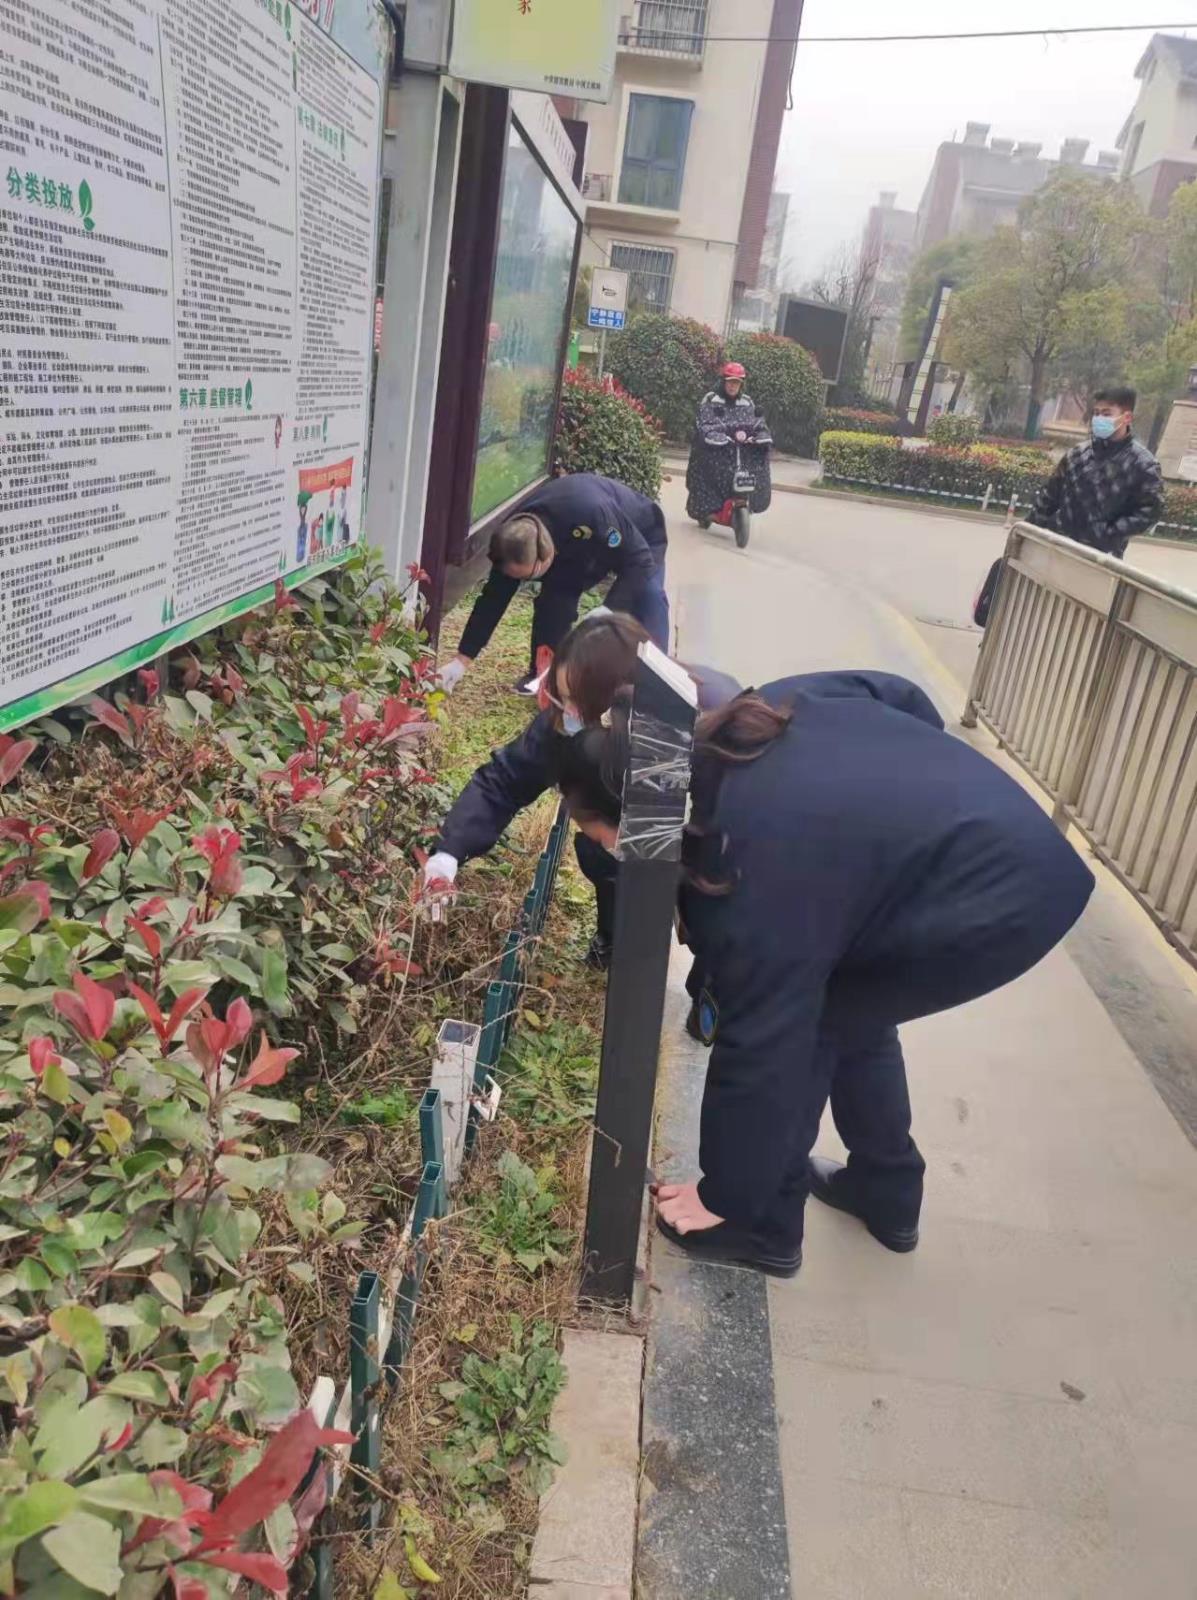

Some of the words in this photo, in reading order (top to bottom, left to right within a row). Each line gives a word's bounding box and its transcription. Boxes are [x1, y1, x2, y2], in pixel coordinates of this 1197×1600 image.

[6, 165, 74, 210] 分类投放
[179, 387, 208, 409] 第六章
